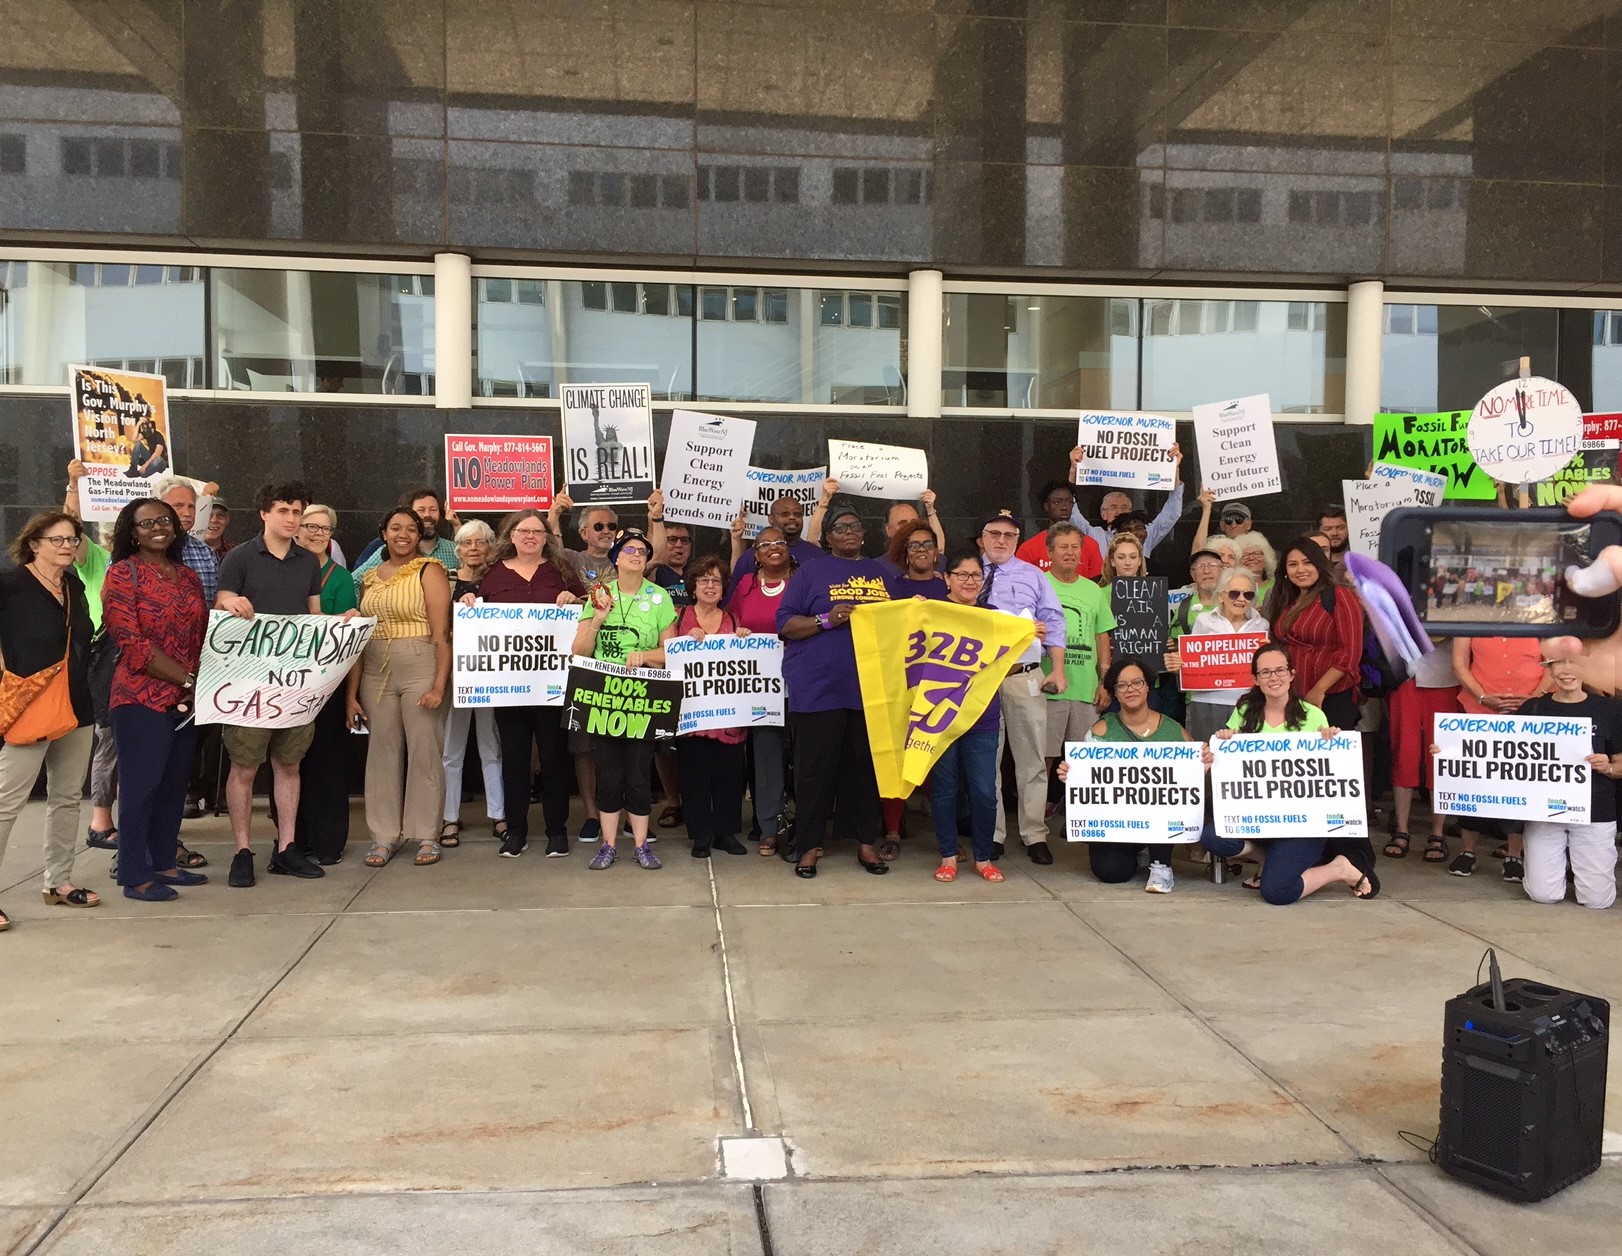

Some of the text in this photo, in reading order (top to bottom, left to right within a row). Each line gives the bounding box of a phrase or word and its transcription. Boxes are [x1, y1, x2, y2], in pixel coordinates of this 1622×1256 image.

[82, 378, 117, 394] Is This
[83, 395, 156, 416] Gov. Murphy's
[566, 389, 647, 409] CLIMATE CHANGE
[1480, 389, 1569, 417] NO TIME
[84, 410, 136, 426] Vision for
[1083, 414, 1173, 430] GOVERNOR MURPHY:
[85, 426, 115, 439] North
[1212, 422, 1256, 438] Support
[1504, 420, 1534, 438] TO
[1097, 430, 1159, 447] NO FOSSIL
[1221, 439, 1252, 451] Clean
[1378, 427, 1470, 460] MORATOR
[1582, 440, 1606, 449] 69866
[86, 441, 126, 456] Jersey?
[452, 441, 502, 455] Call Gov. Murphy:
[686, 440, 734, 457] Support
[1081, 445, 1174, 463] FUEL PROJECTS
[1473, 435, 1577, 463] TAKE OUR TIME!
[571, 446, 648, 481] IS REAL!
[838, 452, 900, 461] Moratorium
[1219, 453, 1257, 466] Energy
[87, 467, 118, 477] OPPOSE
[453, 456, 547, 490] NO Meadowlands
[690, 458, 723, 472] Clean
[1211, 465, 1270, 481] Our future
[88, 478, 151, 488] The Meadowlands
[484, 474, 547, 490] Power Plant
[683, 474, 725, 491] Energy
[746, 470, 794, 484] GOVERNOR
[840, 471, 923, 481] Fossil Fuel Projects
[1251, 476, 1279, 490] on it!
[88, 487, 123, 496] Gas-Fired
[126, 489, 147, 497] Power
[861, 481, 884, 492] Now
[1356, 482, 1378, 490] Place
[669, 488, 732, 506] Our future
[759, 487, 816, 502] NO FOSSIL
[744, 500, 770, 516] FUEL
[1351, 497, 1412, 513] Moratorium
[708, 511, 722, 521] on
[830, 588, 891, 598] GOOD JOBS
[1115, 579, 1163, 600] CLEAN
[457, 607, 580, 621] GOVERNOR MURPHY:
[1126, 600, 1154, 614] AIR
[1152, 615, 1163, 627] A
[209, 615, 374, 666] GARDEN STATE
[600, 631, 617, 641] WE
[1114, 629, 1158, 641] HUMAN
[478, 635, 557, 652] NO FOSSIL
[667, 637, 780, 655] GOVERNOR MURPHY:
[1119, 641, 1162, 655] RIGHT
[1186, 638, 1260, 653] NO PIPELINES
[457, 654, 495, 672] FUEL
[684, 659, 761, 680] NO FOSSIL
[269, 668, 312, 689] NOT
[647, 669, 672, 679] 69866
[458, 685, 531, 694] TEXT NO FOSSIL FUELS
[604, 675, 648, 698] 100%
[685, 678, 781, 699] EL PROJECTS
[214, 683, 283, 720] GAS
[458, 695, 491, 704] TO 69866
[574, 688, 672, 714] RENEWABLES
[692, 709, 715, 719] FOSSIL
[716, 708, 736, 717] FUELS
[587, 707, 652, 739] NOW
[680, 720, 698, 731] 69866
[1438, 718, 1516, 733] GOVERNOR
[1521, 721, 1587, 736] MURPHY:
[1219, 736, 1357, 753] GOVERNOR MURPHY:
[1462, 739, 1560, 761] NO FOSSIL
[1069, 747, 1200, 760] GOVERNOR MURPHY:
[1091, 767, 1177, 784] NO FOSSIL
[1242, 758, 1334, 778] NO FOSSIL
[1438, 759, 1586, 784] FUEL PROJECTS
[1070, 787, 1200, 805] FUEL PROJECTS
[1220, 779, 1361, 800] FUEL PROJECTS
[1438, 792, 1527, 806] TEXT NO FOSSIL FUELS
[1439, 802, 1478, 812] TO 69866
[1088, 820, 1099, 828] NO
[1100, 820, 1125, 828] FOSSIL
[1127, 821, 1149, 829] FUELS
[1224, 814, 1307, 823] TEXT NO FOSSIL FUELS
[1071, 829, 1105, 837] TO 69866
[1224, 825, 1261, 834] TO 69866
